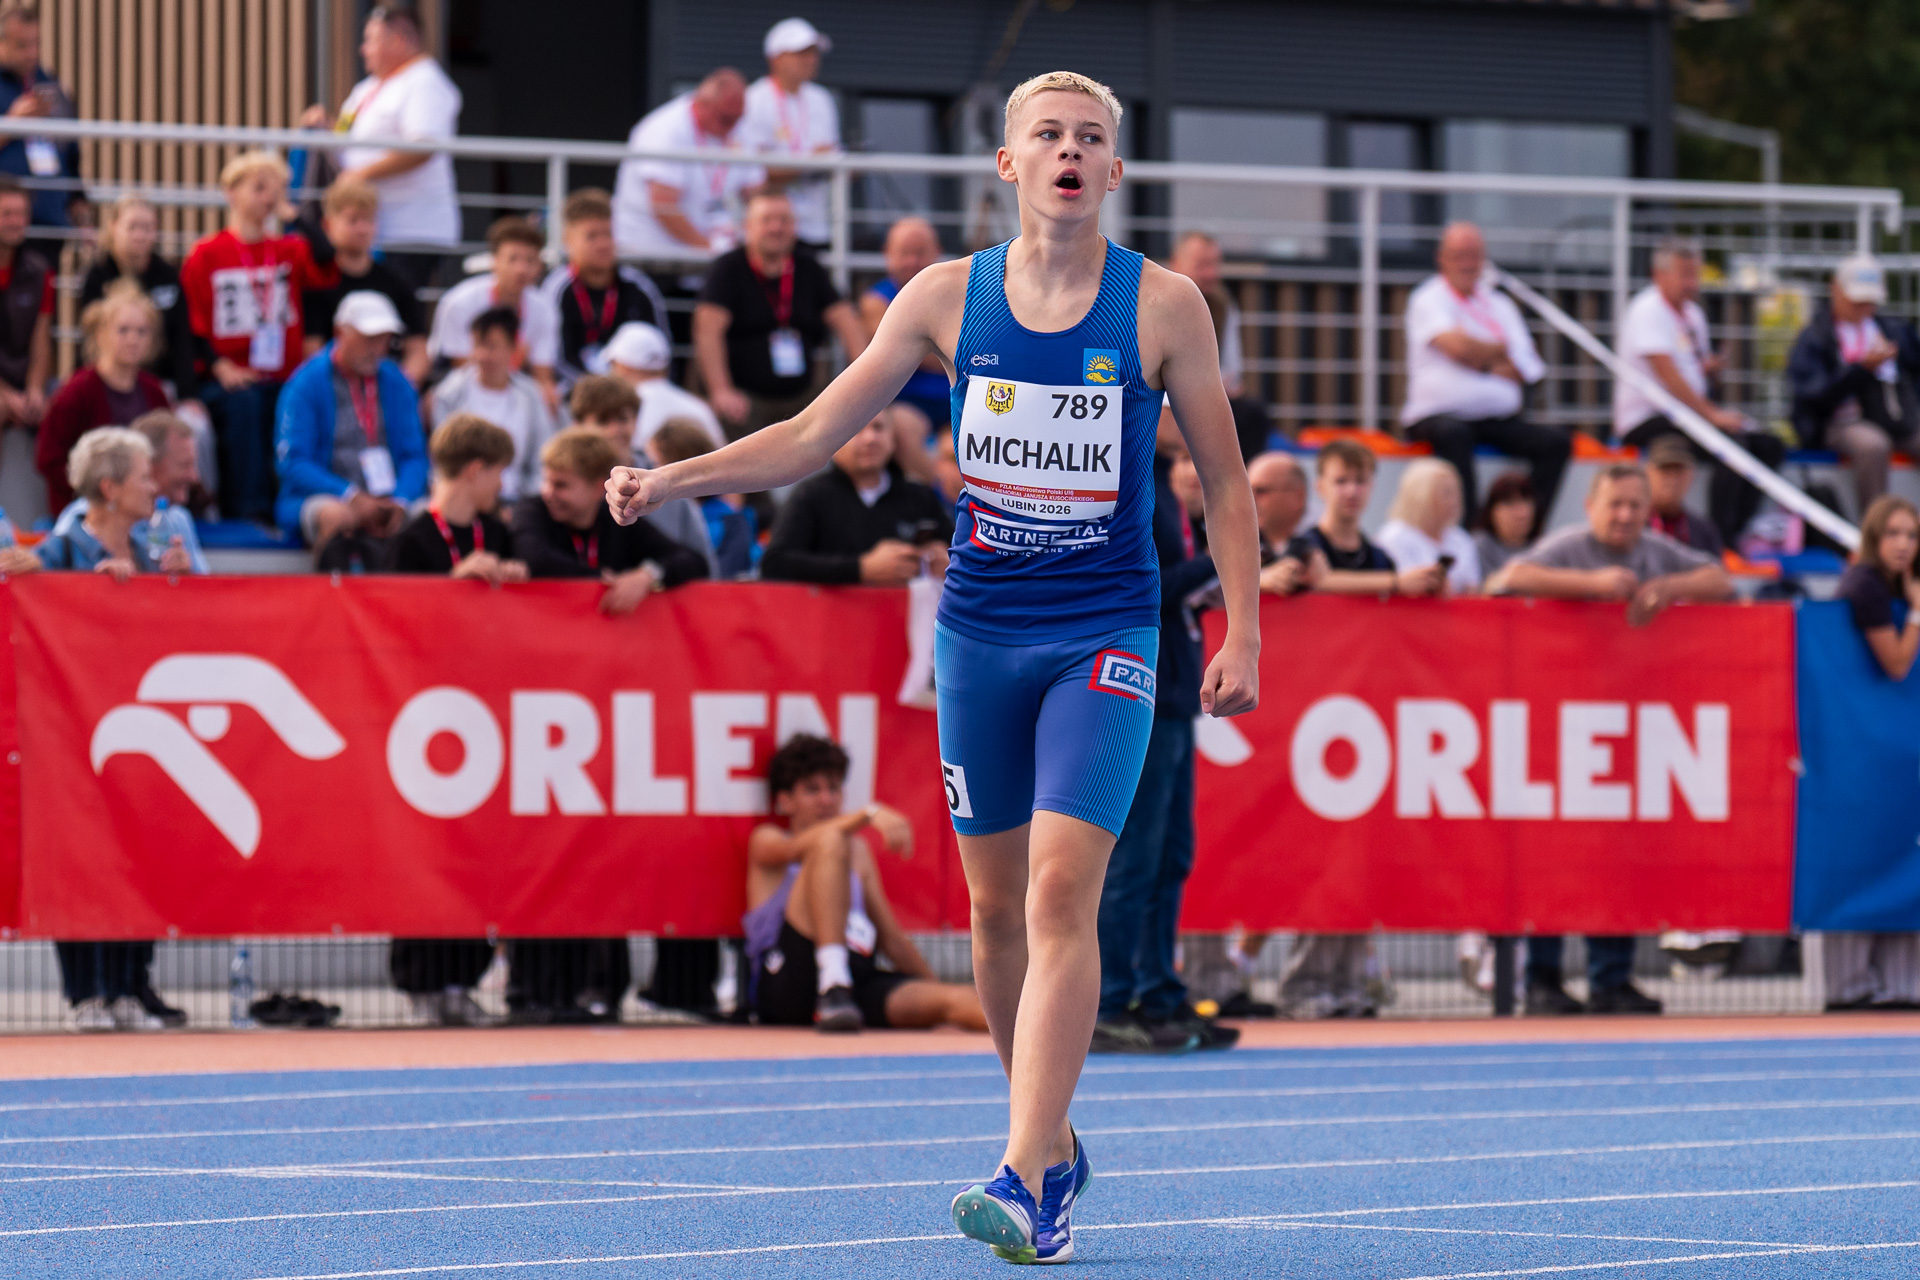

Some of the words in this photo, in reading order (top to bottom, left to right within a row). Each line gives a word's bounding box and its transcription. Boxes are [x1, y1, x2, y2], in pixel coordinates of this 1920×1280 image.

[1051, 393, 1108, 420] 789
[966, 433, 1112, 473] MICHALIK
[1013, 485, 1046, 494] Mistrzostwa
[1023, 492, 1048, 500] JANUSZA
[1001, 498, 1039, 512] LUBIN
[1039, 504, 1071, 515] 2026
[386, 685, 879, 818] ORLEN
[1290, 693, 1730, 822] ORLEN
[943, 764, 960, 811] 5
